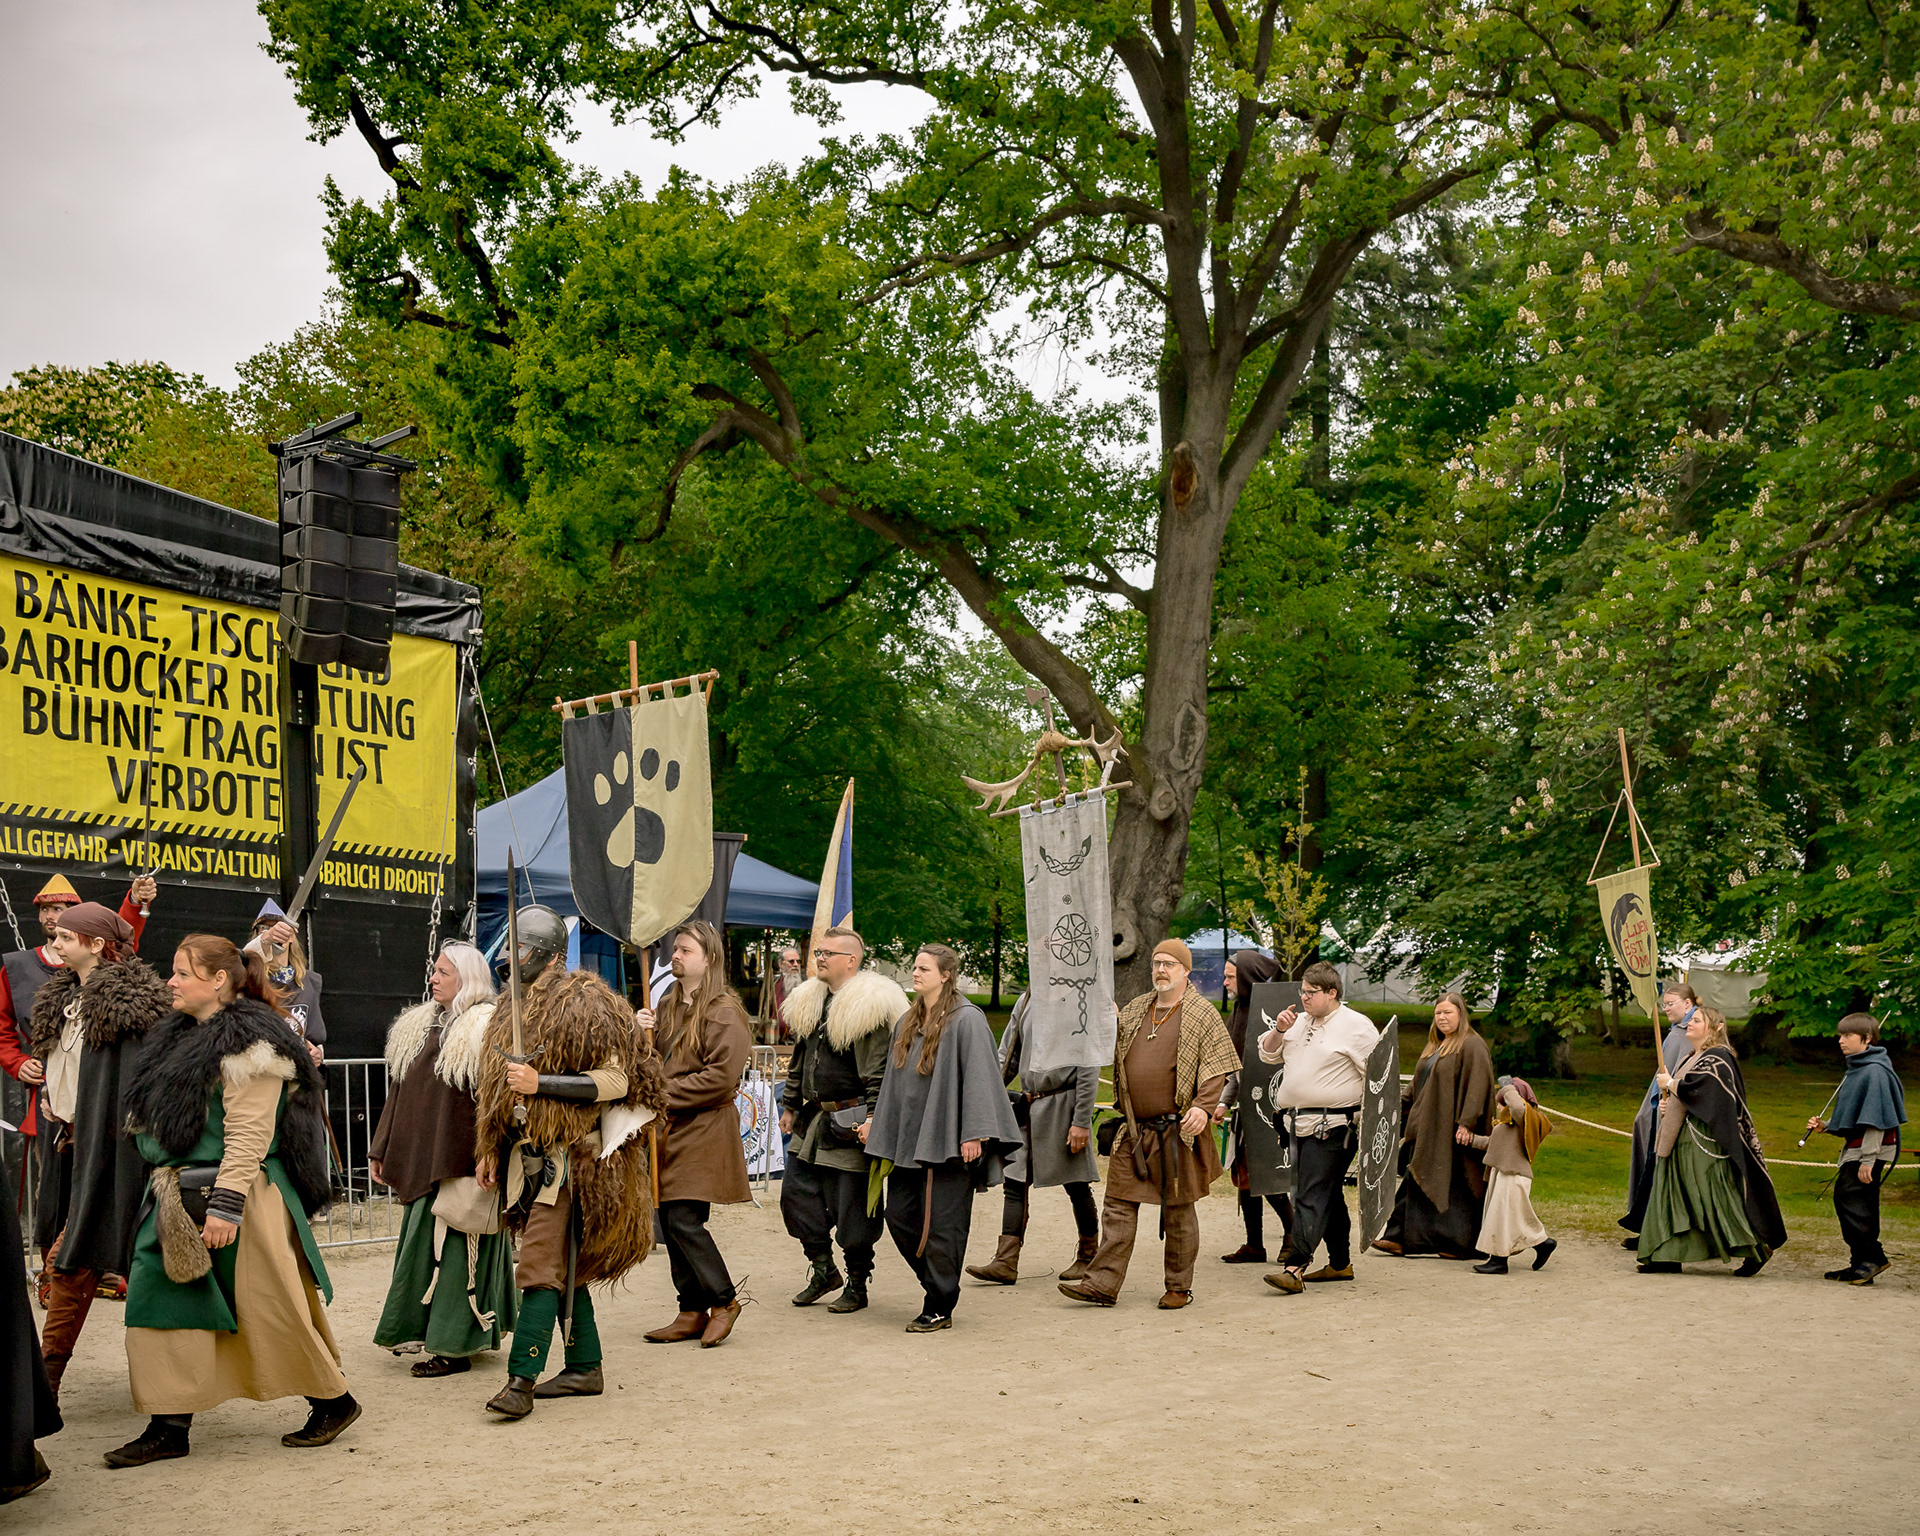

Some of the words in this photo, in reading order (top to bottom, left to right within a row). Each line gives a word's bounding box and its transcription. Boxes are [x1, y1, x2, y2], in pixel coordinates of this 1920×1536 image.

[14, 570, 171, 652] BÄNKE,
[182, 604, 283, 666] TISCH
[22, 684, 164, 753] BÜHNE
[174, 711, 324, 776] TRAG
[336, 736, 388, 785] IST
[241, 668, 415, 740] RITUNG
[106, 755, 282, 822] VERBOTE
[384, 867, 445, 896] DROHT!
[1623, 939, 1643, 957] EST
[1629, 954, 1651, 971] OM
